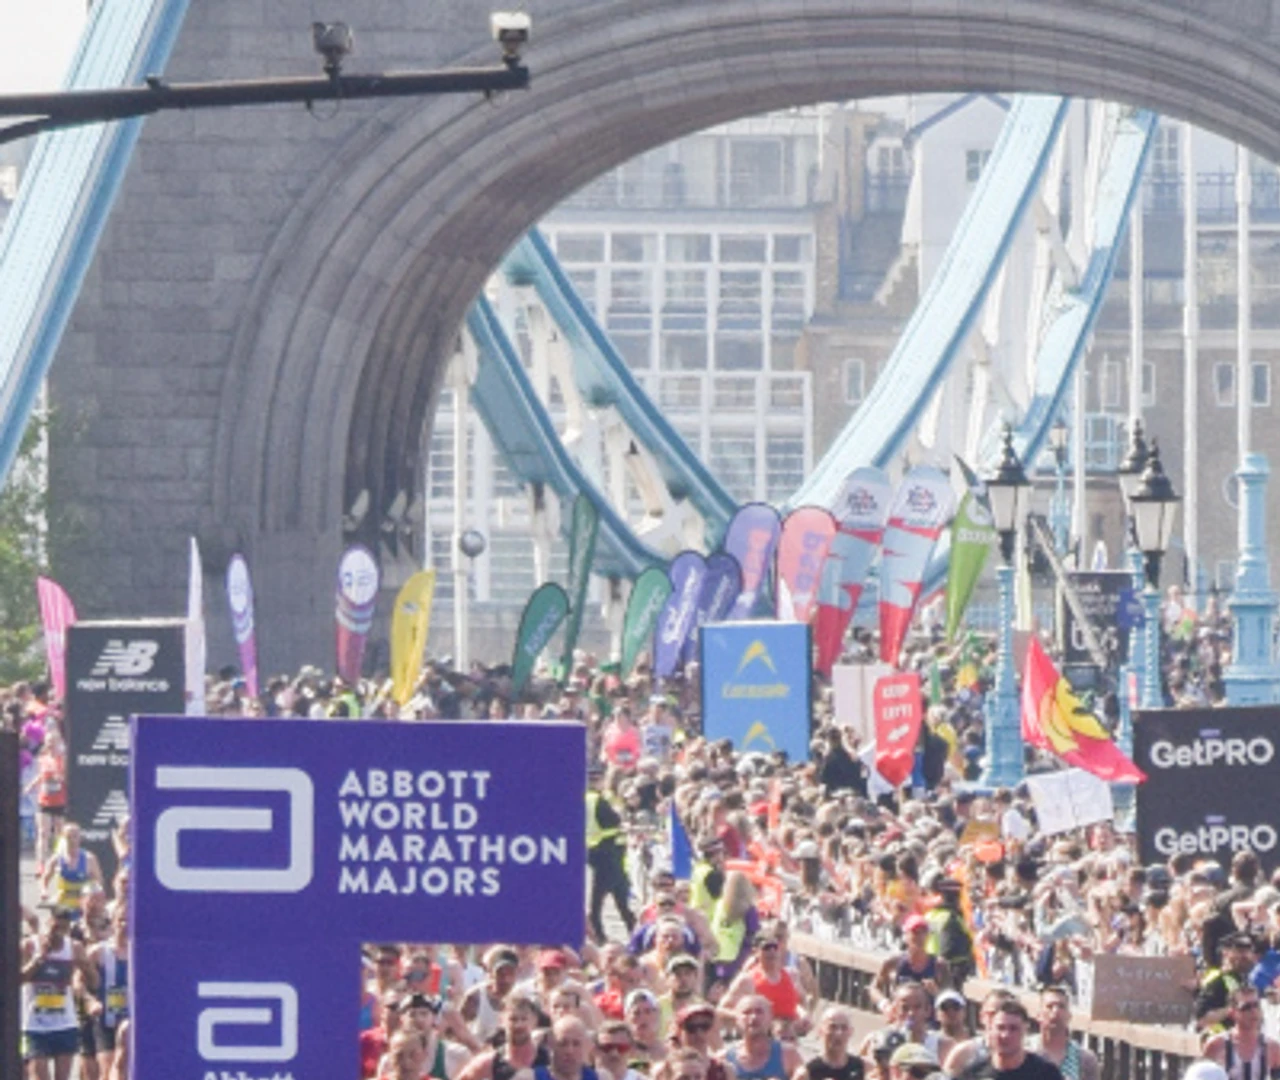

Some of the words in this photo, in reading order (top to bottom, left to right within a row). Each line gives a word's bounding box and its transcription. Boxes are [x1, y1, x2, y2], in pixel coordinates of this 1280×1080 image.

[109, 678, 170, 692] balance
[1150, 738, 1275, 768] GetPRO
[338, 770, 491, 799] ABBOTT
[338, 802, 479, 830] WORLD
[338, 835, 568, 865] MARATHON
[1154, 823, 1279, 856] GetPRO
[338, 867, 502, 896] MAJORS
